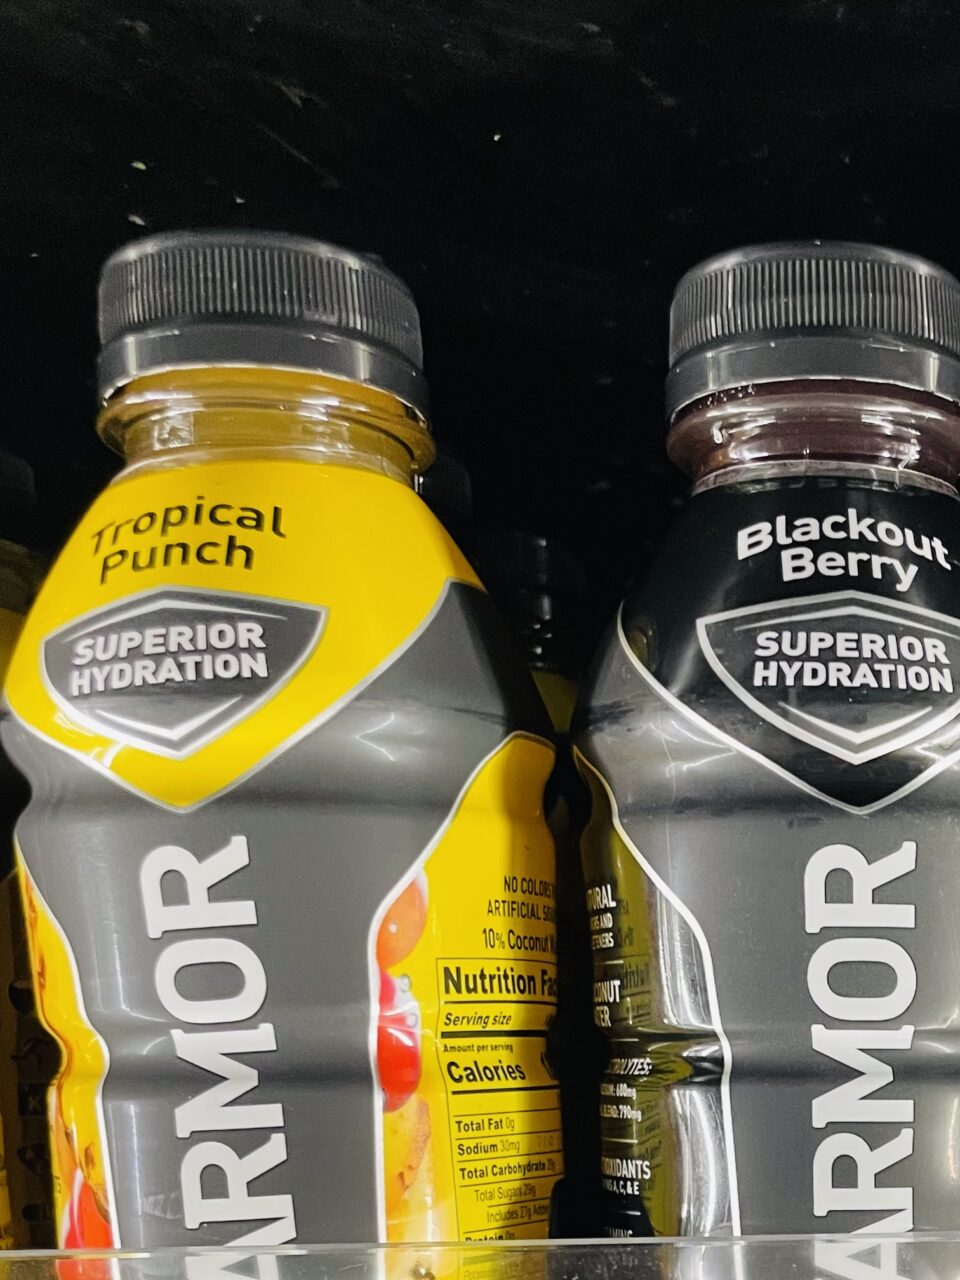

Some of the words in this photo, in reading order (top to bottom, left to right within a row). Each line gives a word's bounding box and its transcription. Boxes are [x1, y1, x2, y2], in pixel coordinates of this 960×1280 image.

[91, 496, 286, 555] Tropical
[736, 508, 952, 570] Blackout
[100, 535, 256, 585] Punch
[781, 547, 918, 591] Berry
[73, 621, 267, 666] SUPERIOR
[754, 630, 950, 665] SUPERIOR
[71, 653, 269, 697] HYDRATION
[752, 661, 954, 694] HYDRATION
[504, 876, 517, 893] NO
[487, 899, 541, 920] ARTIFICIAL
[482, 928, 505, 949] 10%
[443, 966, 536, 996] Nutrition
[444, 1012, 489, 1030] Serving
[492, 1012, 511, 1025] size
[443, 1043, 474, 1053] Amount
[477, 1044, 489, 1054] per
[447, 1060, 526, 1084] Calories
[455, 1119, 484, 1132] Total
[488, 1118, 503, 1130] Fat
[457, 1142, 498, 1156] Sodium
[500, 1140, 520, 1153] 30mg
[459, 1165, 488, 1180] Total
[491, 1160, 546, 1177] Carbohydrate
[474, 1188, 495, 1202] Total
[497, 1186, 522, 1201] Sugars
